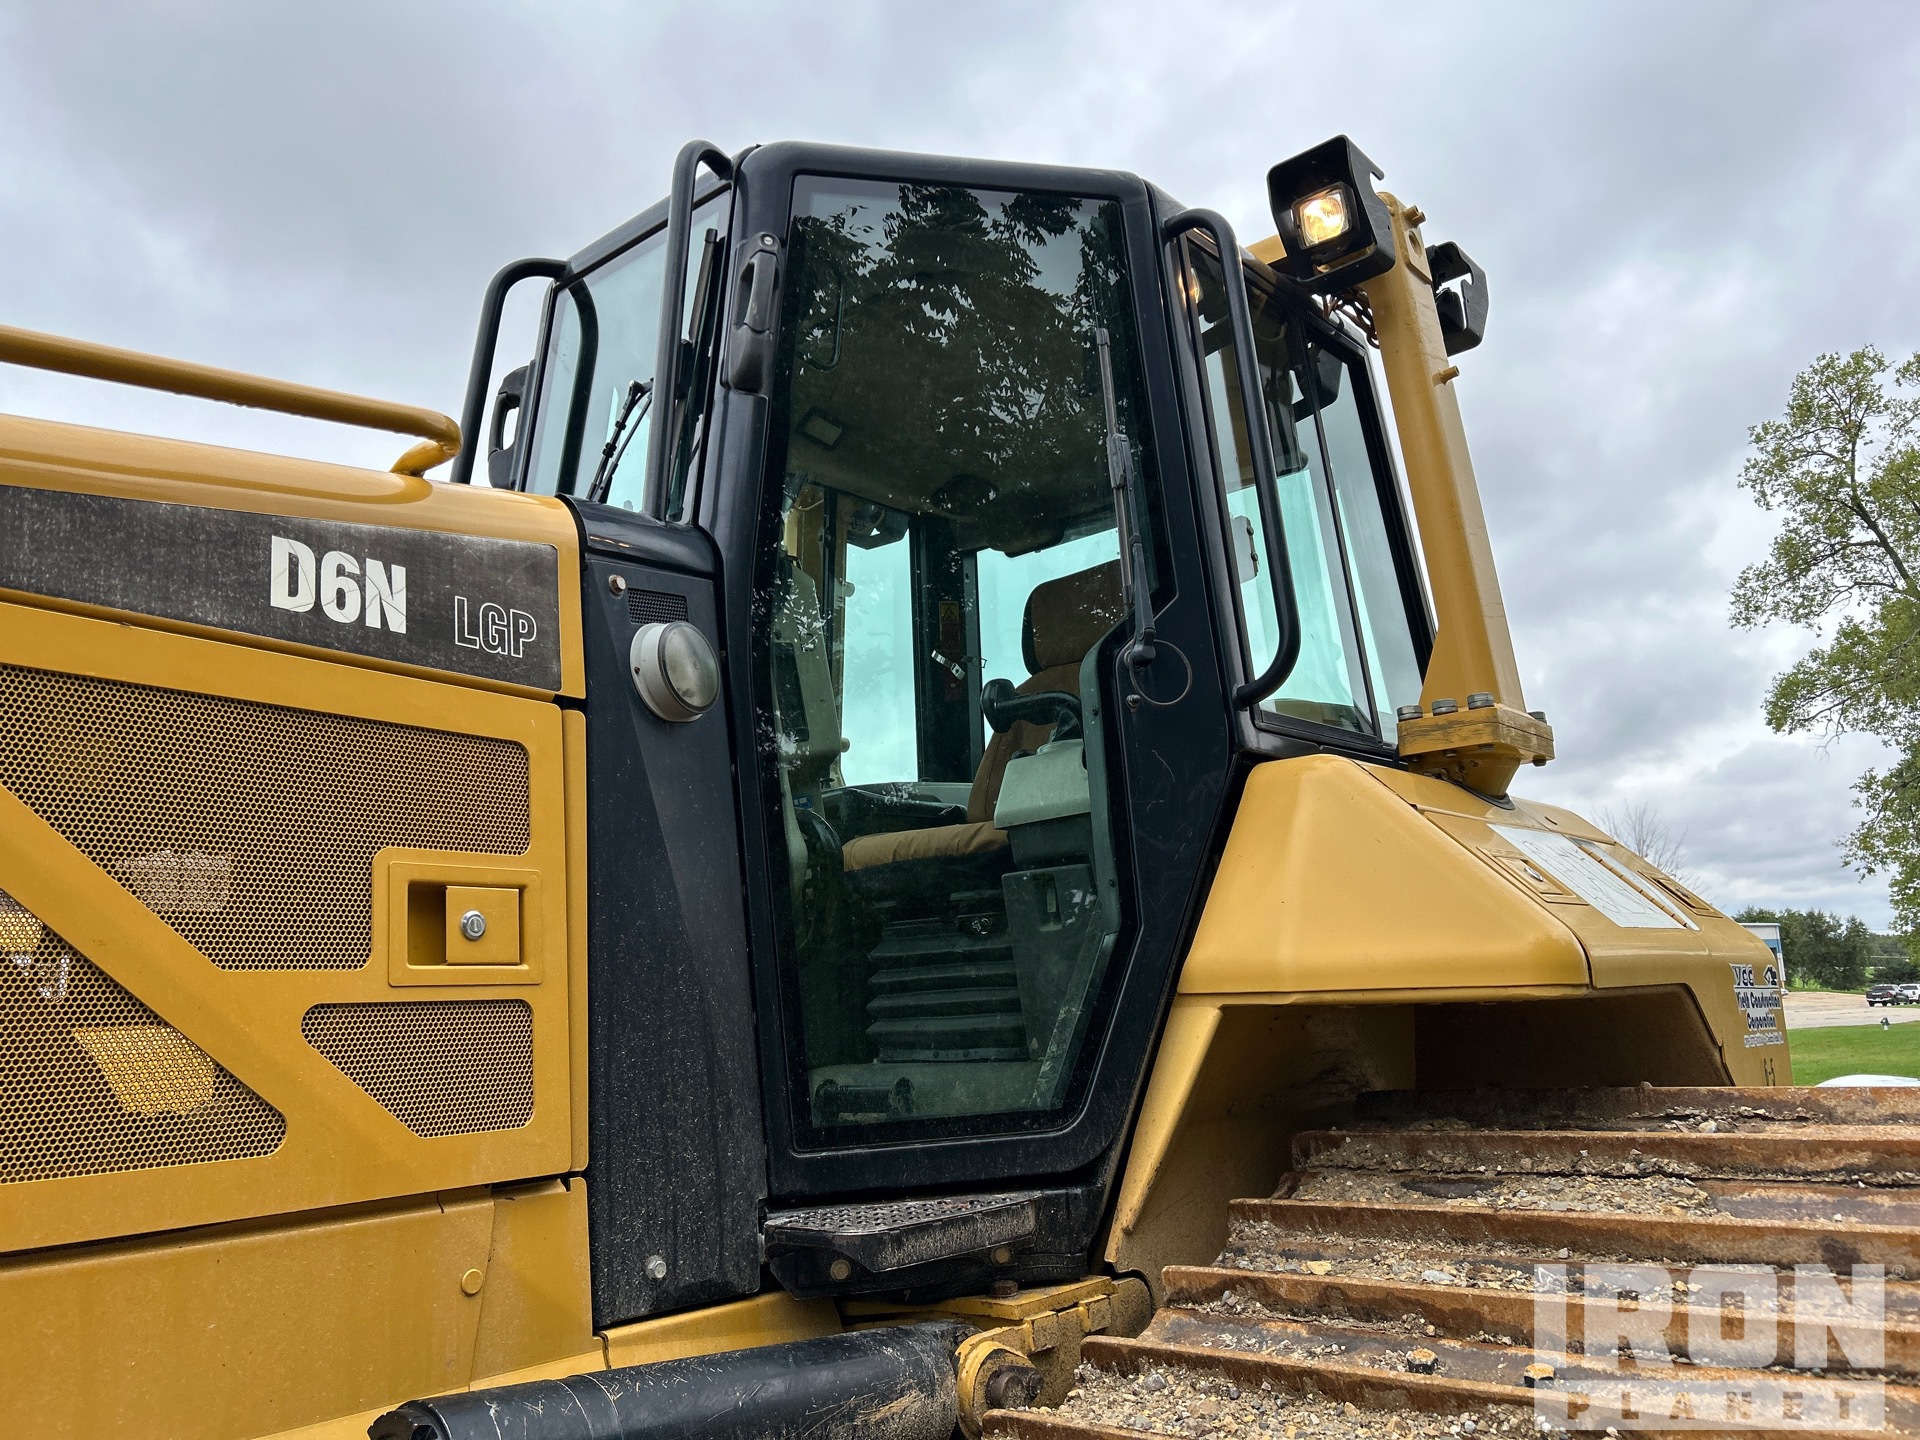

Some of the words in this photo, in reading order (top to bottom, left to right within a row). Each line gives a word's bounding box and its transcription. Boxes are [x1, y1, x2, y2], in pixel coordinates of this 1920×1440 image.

[270, 535, 406, 634] D6N
[454, 596, 537, 658] LGP
[1747, 1012, 1776, 1030] Corporation
